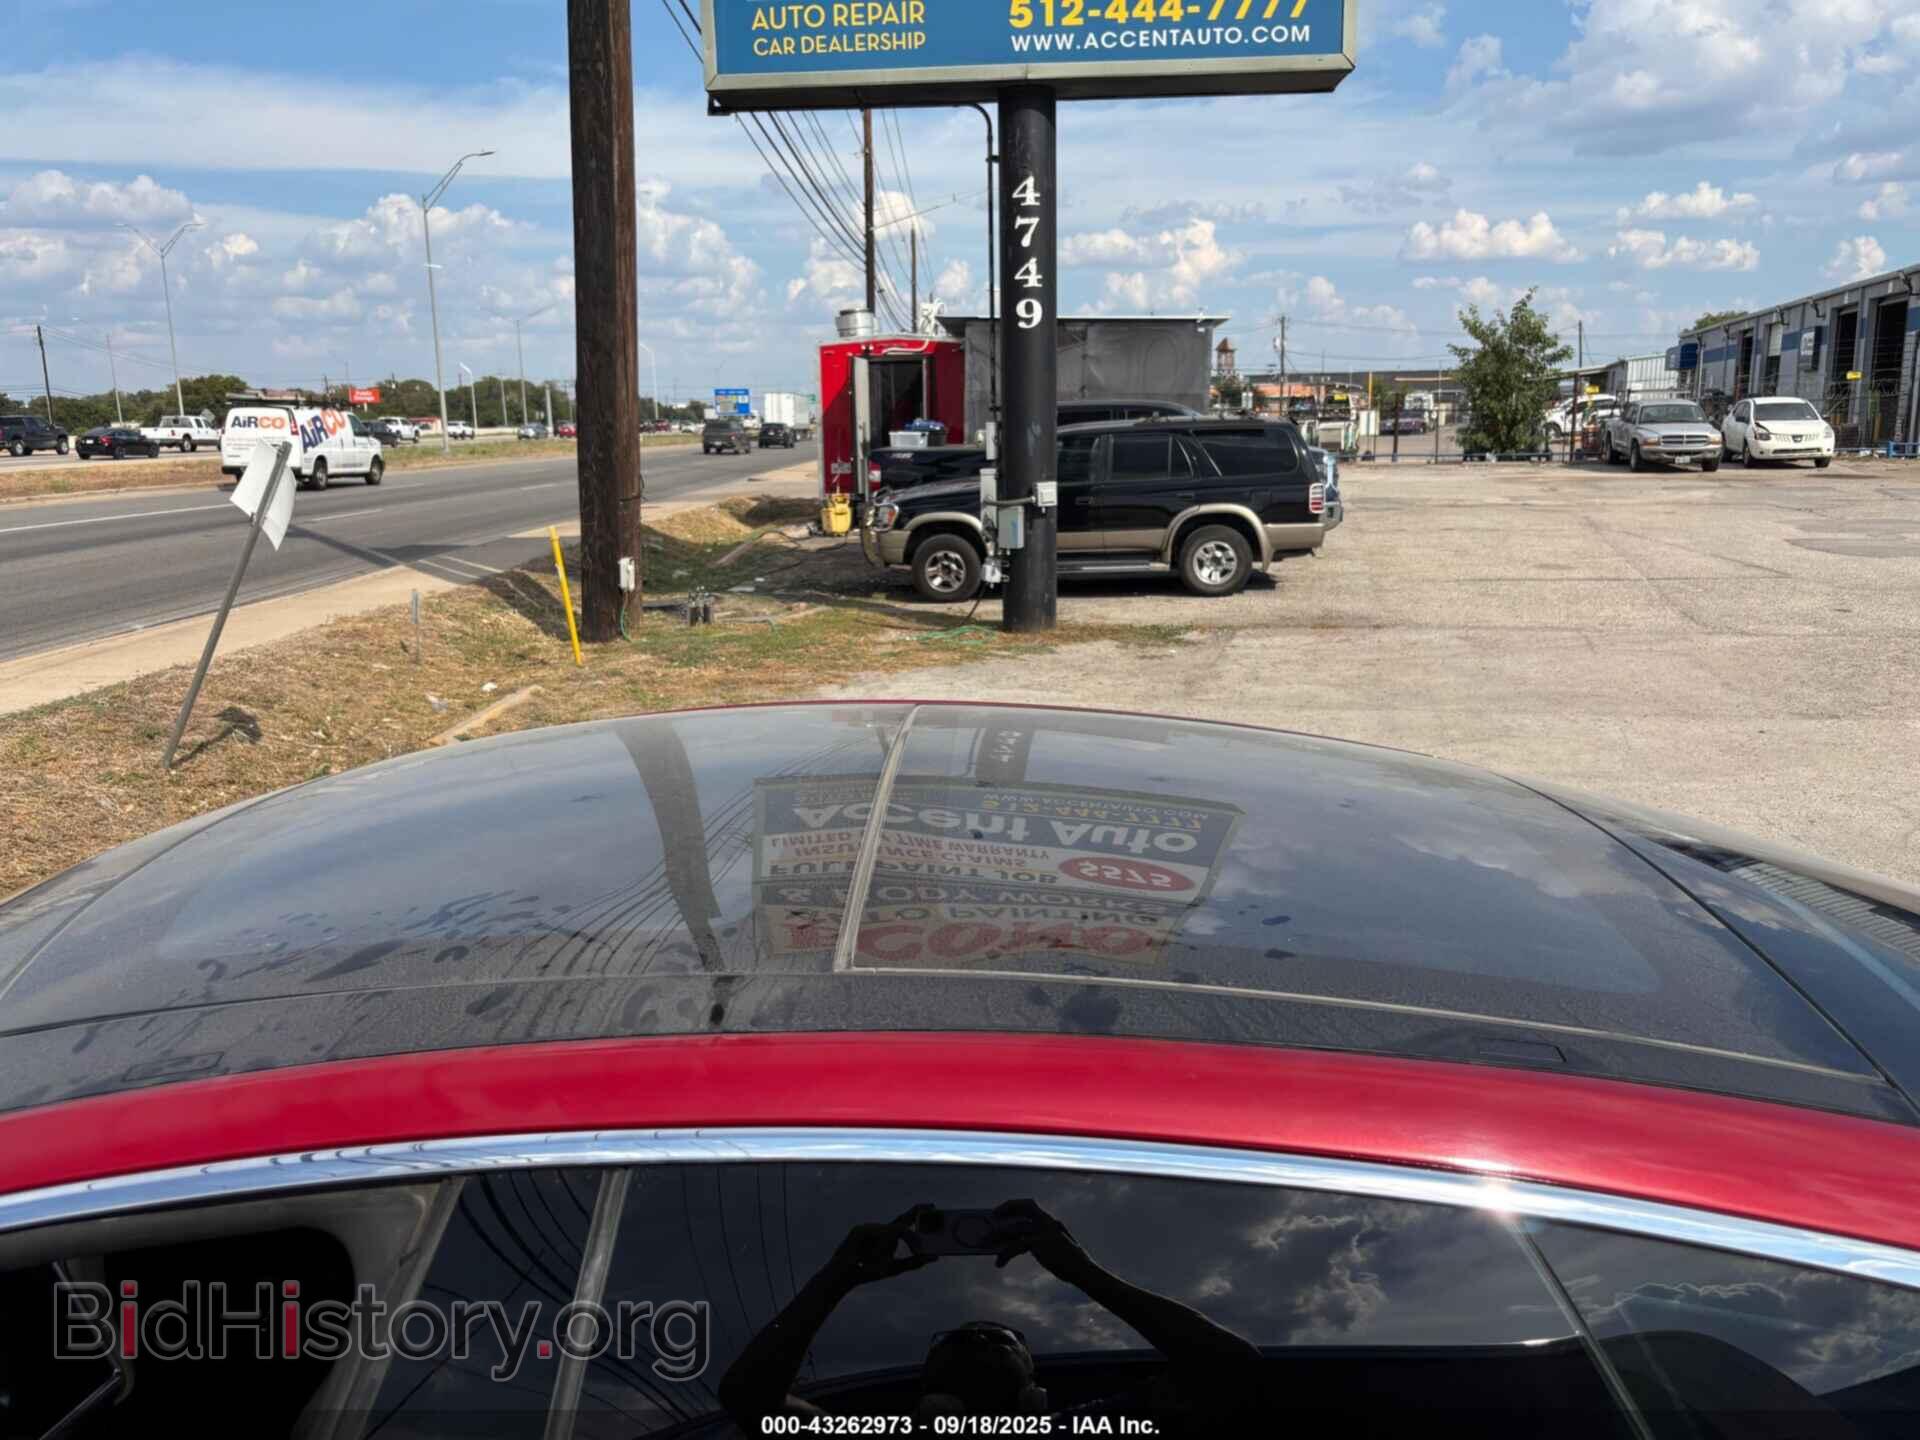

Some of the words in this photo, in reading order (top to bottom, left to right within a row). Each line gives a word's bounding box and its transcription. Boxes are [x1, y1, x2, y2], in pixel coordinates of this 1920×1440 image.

[751, 4, 826, 31] AUTO
[832, 0, 926, 27] REPAIR
[752, 36, 796, 57] CAR
[800, 31, 927, 55] DEALERSHIP
[1010, 24, 1311, 52] WWW.ACCENTAUTO.COM
